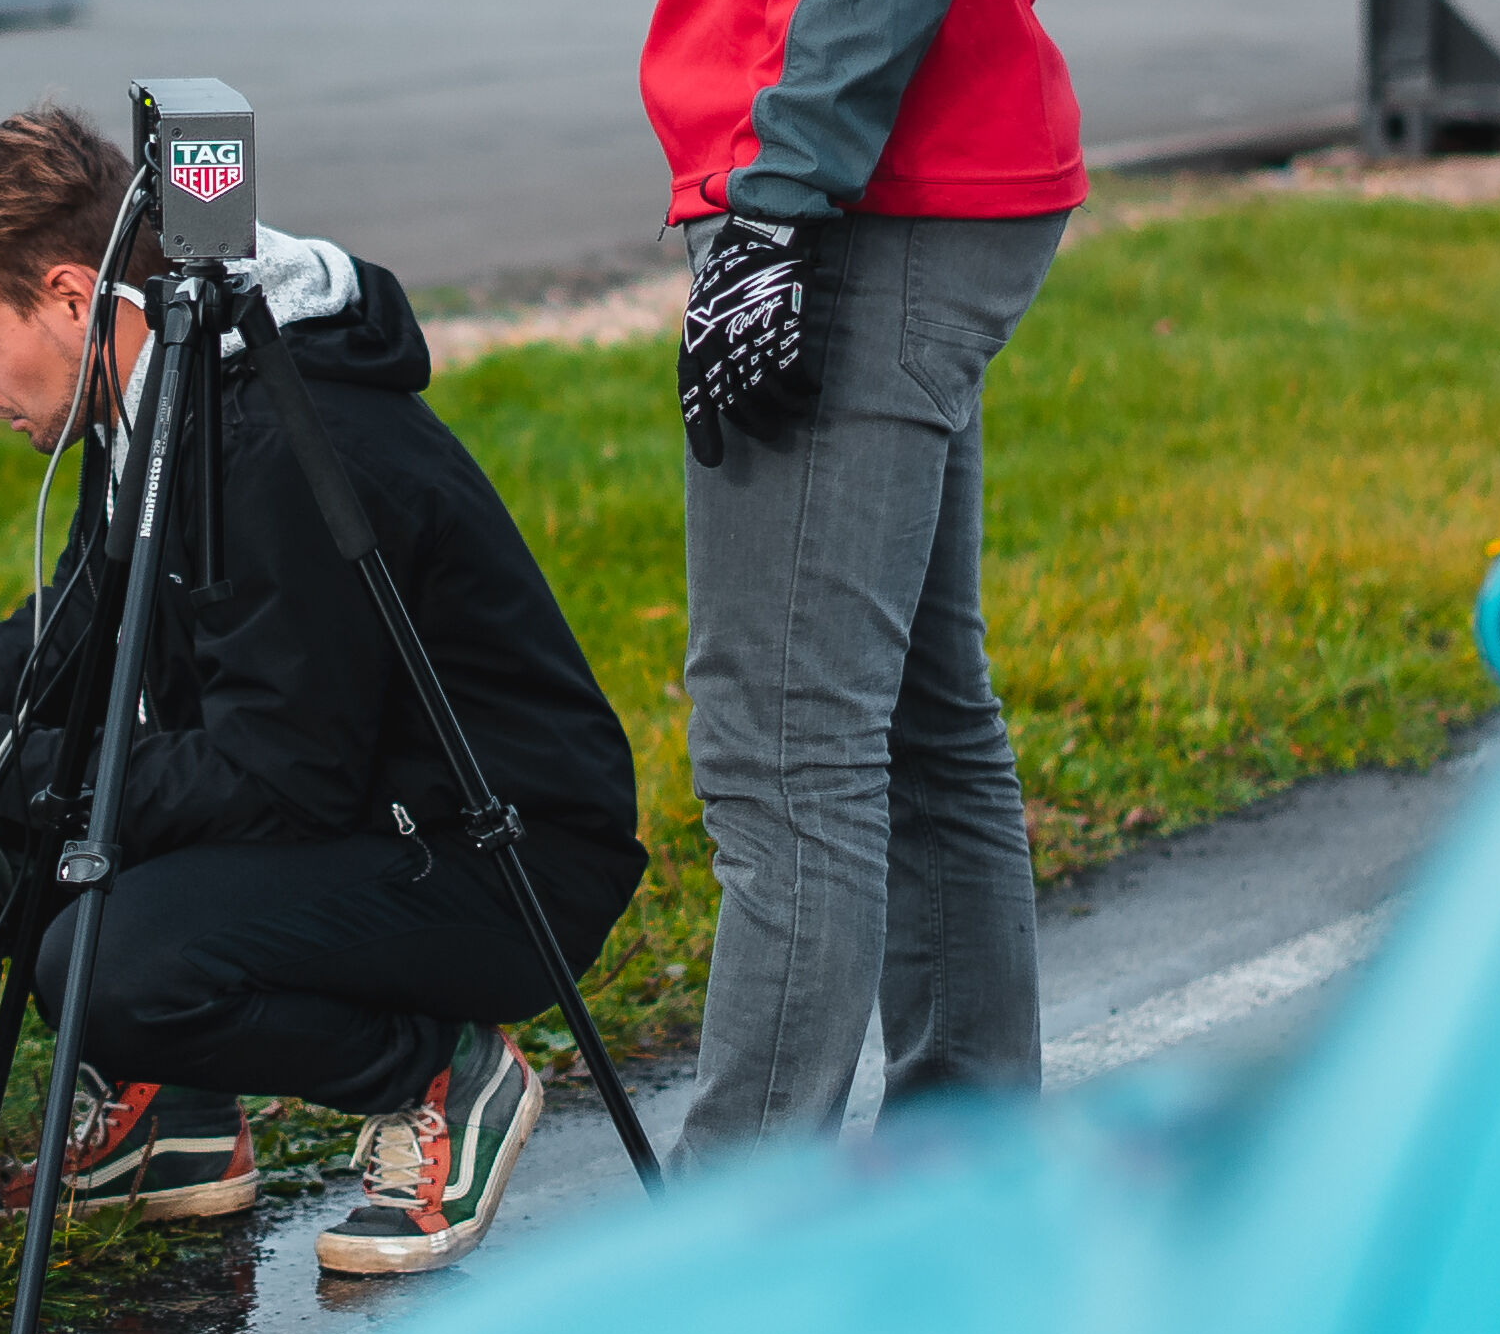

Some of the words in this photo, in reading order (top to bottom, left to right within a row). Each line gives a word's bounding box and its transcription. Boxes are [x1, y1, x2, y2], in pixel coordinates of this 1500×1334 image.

[177, 145, 236, 164] TAG
[175, 168, 239, 197] HEUER
[725, 295, 783, 344] Racing
[140, 457, 162, 537] Manfrotto
